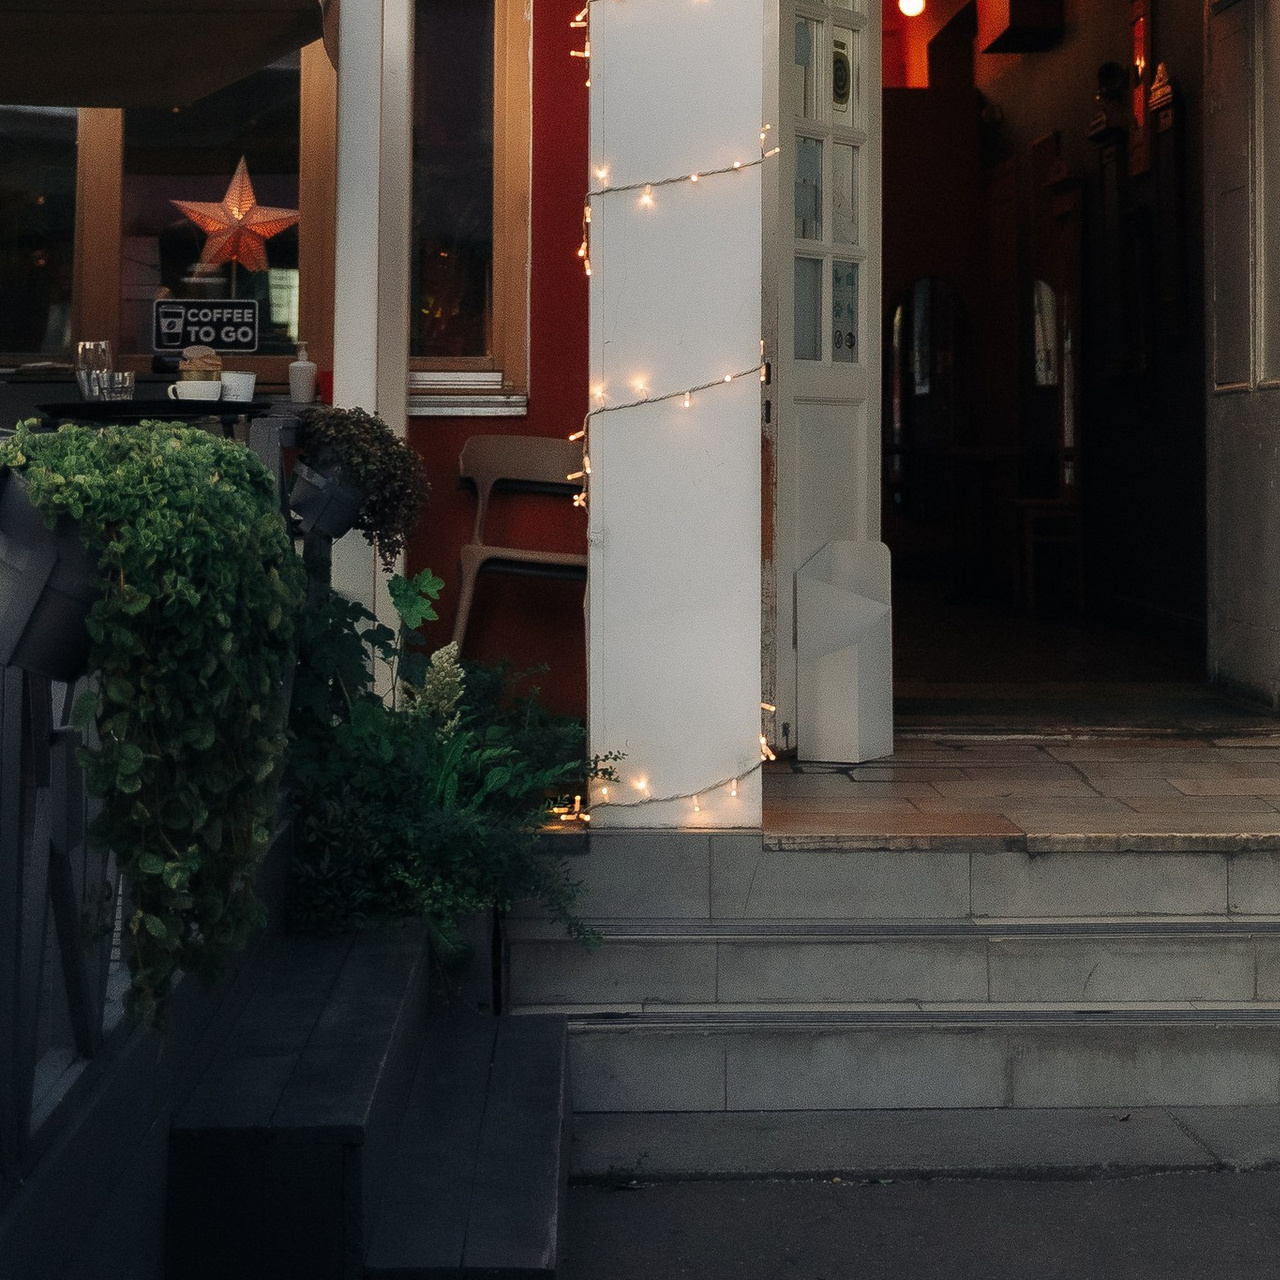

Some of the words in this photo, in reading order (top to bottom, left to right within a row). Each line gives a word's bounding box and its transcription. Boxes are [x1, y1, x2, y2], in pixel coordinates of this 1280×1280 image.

[187, 309, 253, 322] COFFEE
[187, 326, 215, 342] TO
[221, 326, 253, 342] GO
